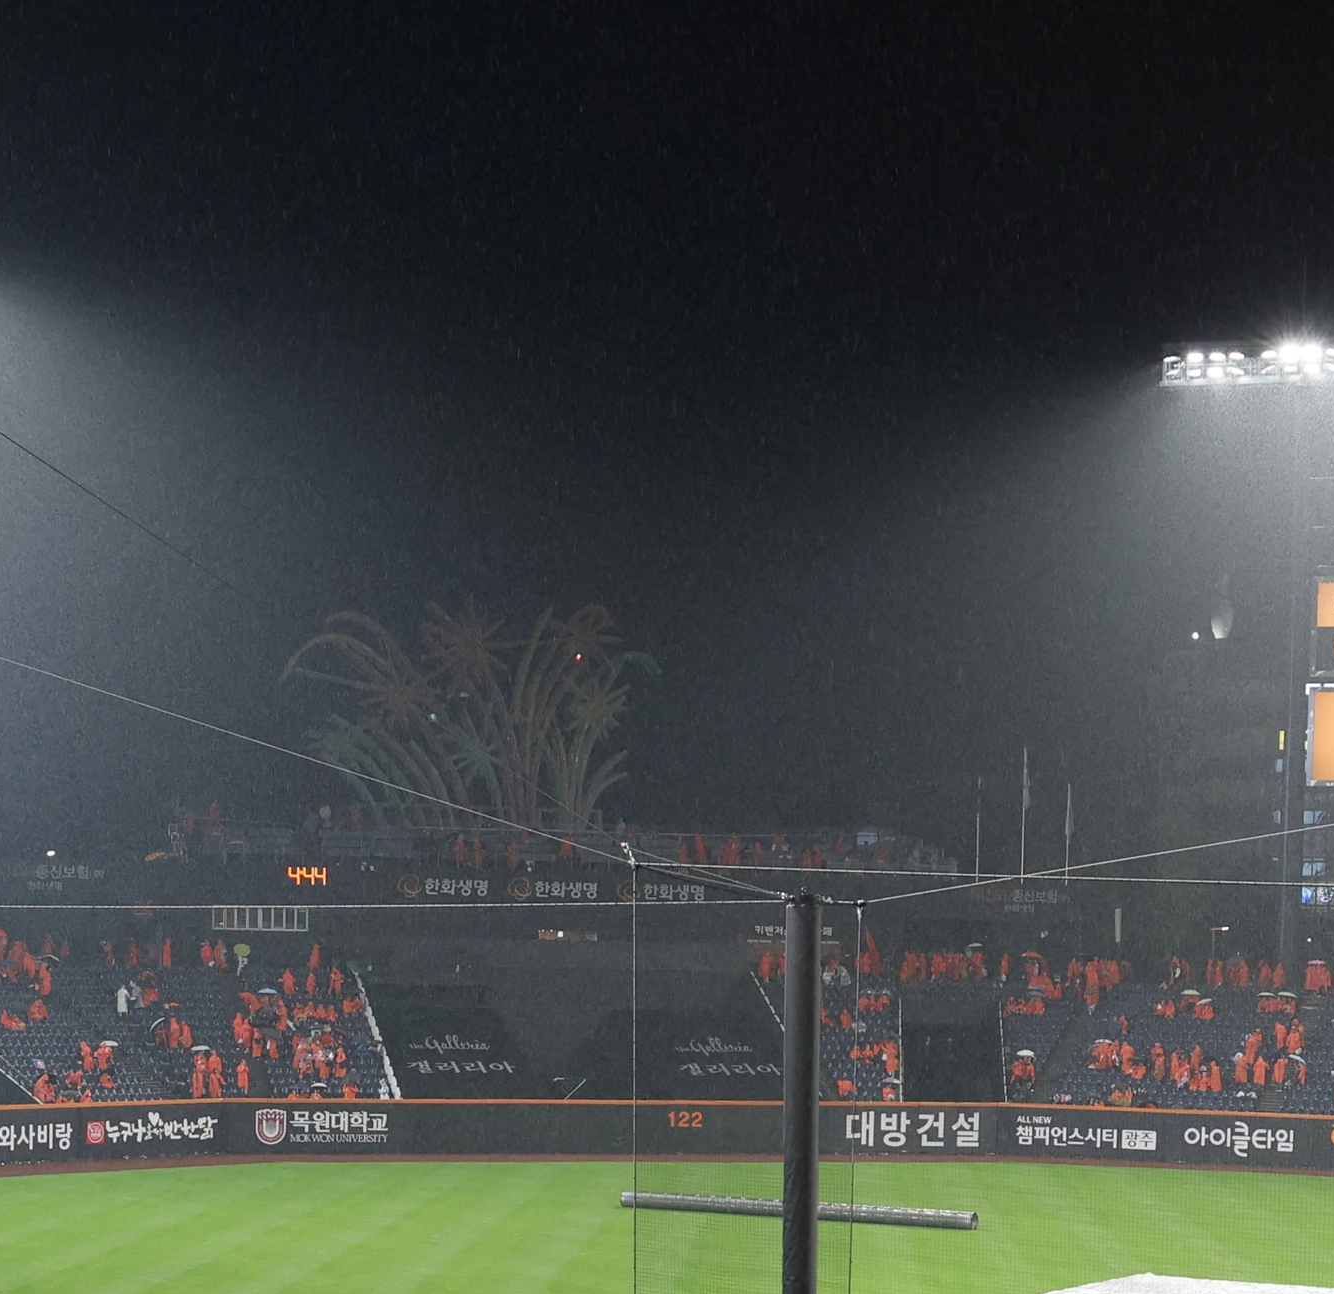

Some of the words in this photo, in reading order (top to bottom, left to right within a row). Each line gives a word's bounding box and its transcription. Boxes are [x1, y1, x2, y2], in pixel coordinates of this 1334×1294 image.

[424, 878, 489, 897] 한화생명
[534, 880, 598, 900] 한화생명
[643, 883, 705, 901] 한화생명
[424, 1034, 491, 1055] Galleria
[406, 1060, 517, 1074] 갤러리아
[678, 1062, 783, 1076] 갤러리아
[289, 1110, 389, 1133] 목원대학교
[668, 1110, 703, 1128] 122
[845, 1110, 980, 1147] 대방건설
[1017, 1115, 1031, 1124] ALL
[1032, 1115, 1052, 1124] NEW
[338, 1134, 389, 1143] UNIVERSITY
[1015, 1125, 1118, 1149] 챔피언스시티
[1123, 1130, 1155, 1149] 광주
[1183, 1120, 1295, 1158] 아이클타임
